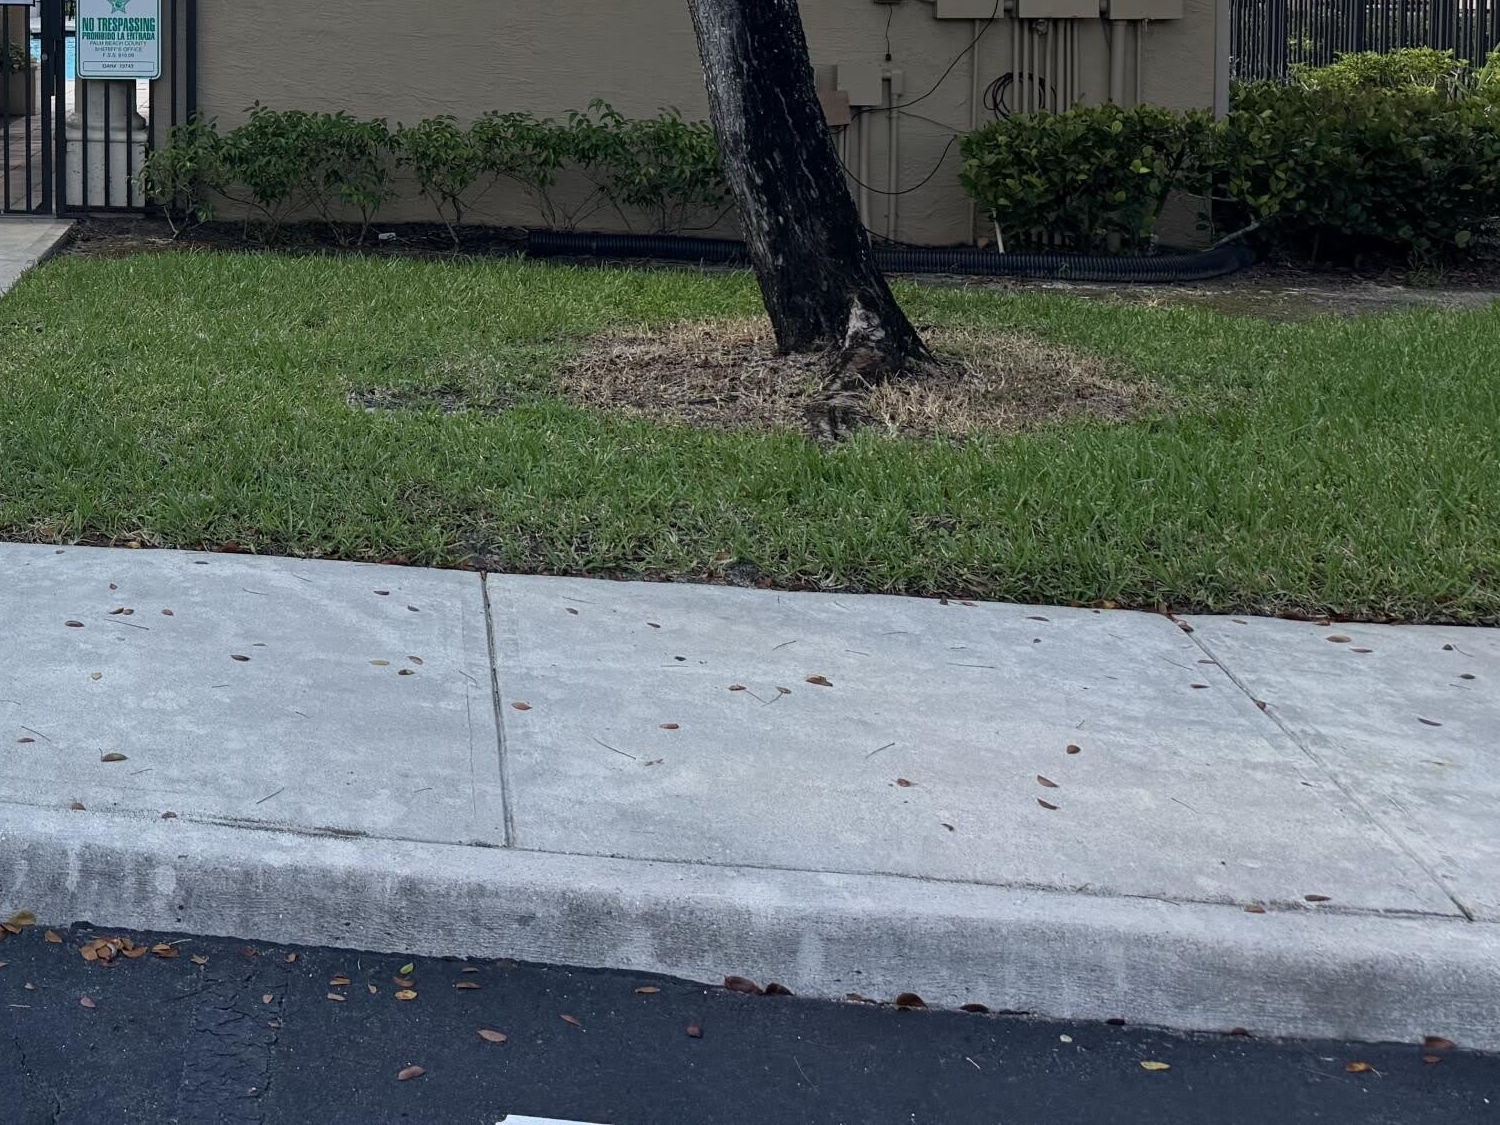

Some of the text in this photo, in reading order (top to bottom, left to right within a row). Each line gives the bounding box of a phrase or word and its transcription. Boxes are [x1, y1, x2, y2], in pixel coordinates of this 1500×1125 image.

[82, 17, 155, 32] NO TRESPASSING
[82, 32, 155, 40] PROHIBIDO LA ENTRADA
